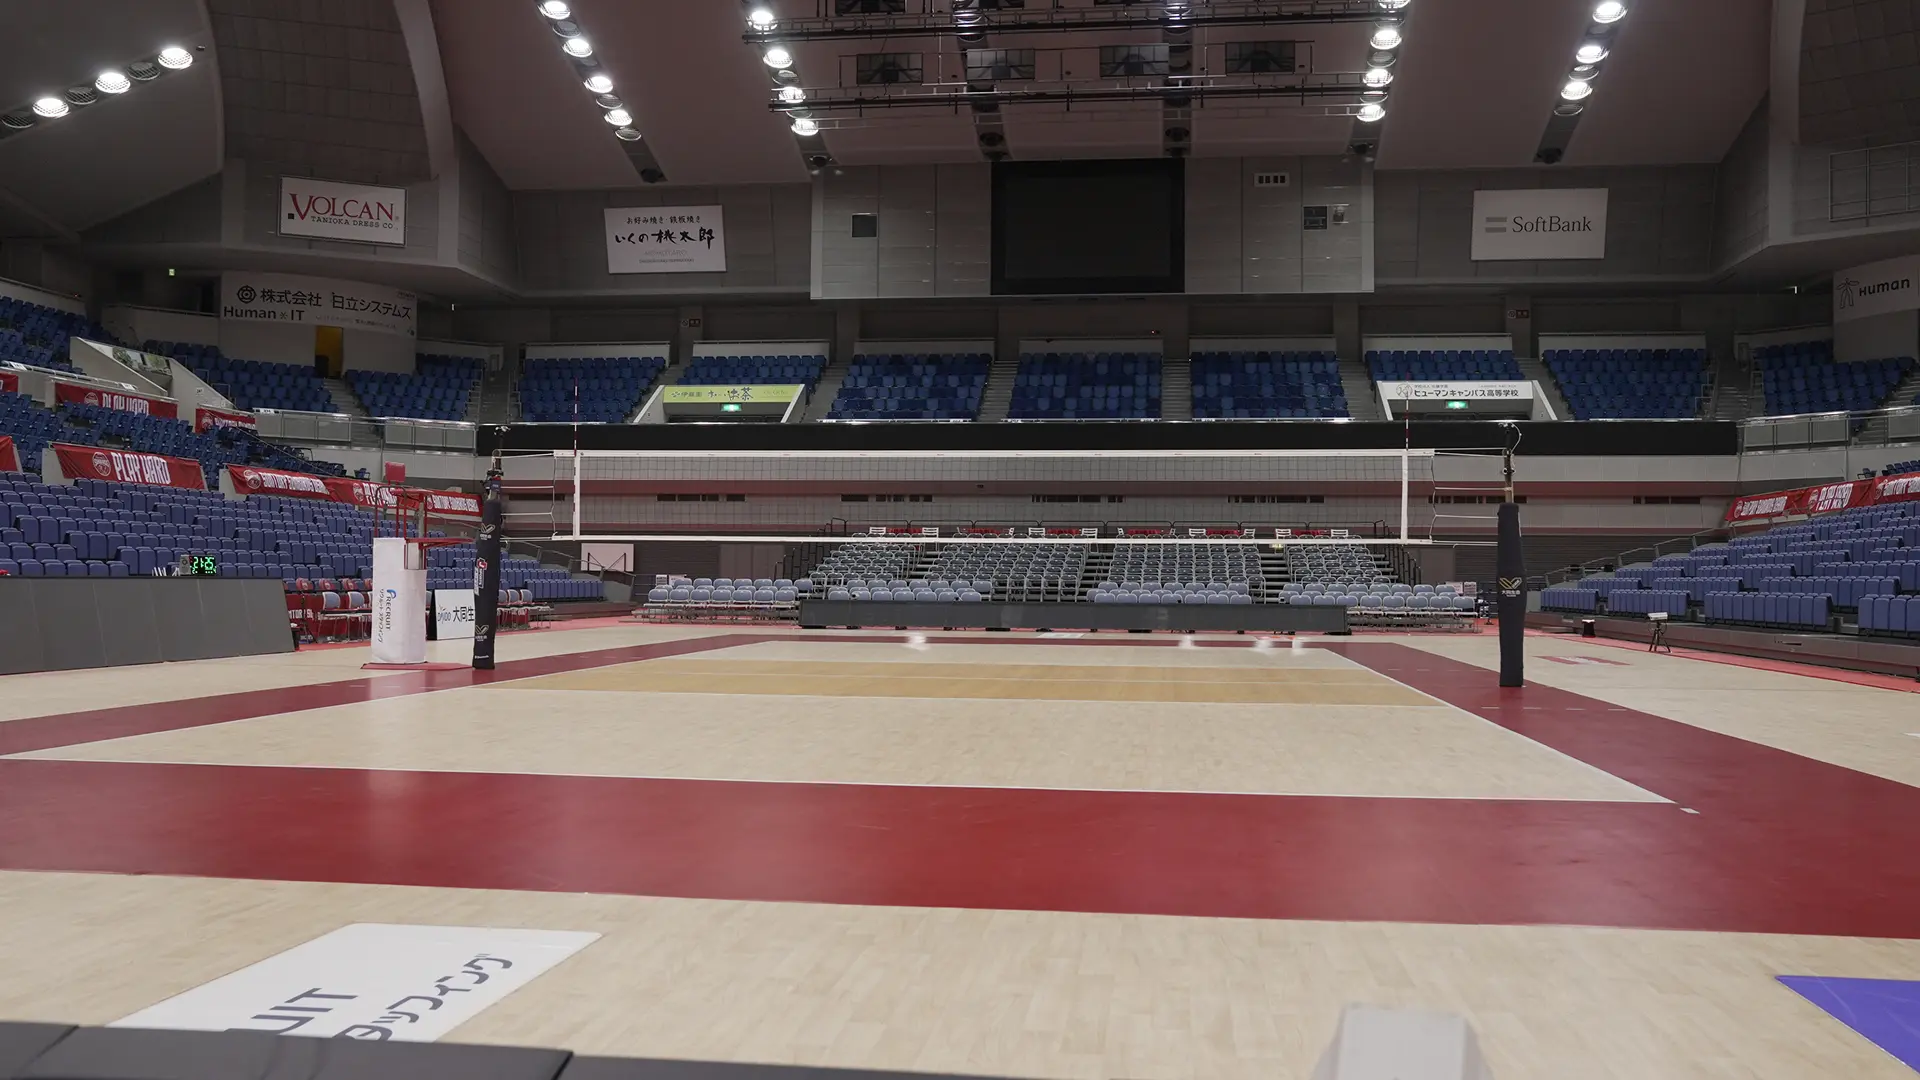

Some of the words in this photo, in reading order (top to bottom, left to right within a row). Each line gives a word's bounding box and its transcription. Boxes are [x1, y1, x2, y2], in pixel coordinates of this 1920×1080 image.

[289, 193, 394, 221] VOLCAN
[310, 216, 350, 226] TANIOKA
[353, 220, 380, 228] DRESS
[1511, 215, 1592, 233] SoftBank
[614, 226, 715, 250] いくの桃太郎
[1859, 278, 1910, 297] Human
[260, 288, 322, 307] 株式会社
[223, 306, 277, 320] Human
[290, 310, 305, 321] IT
[1414, 389, 1519, 397] ヒューマンキャンパス高等学校
[111, 452, 143, 482] PLAY
[140, 455, 171, 485] HARD
